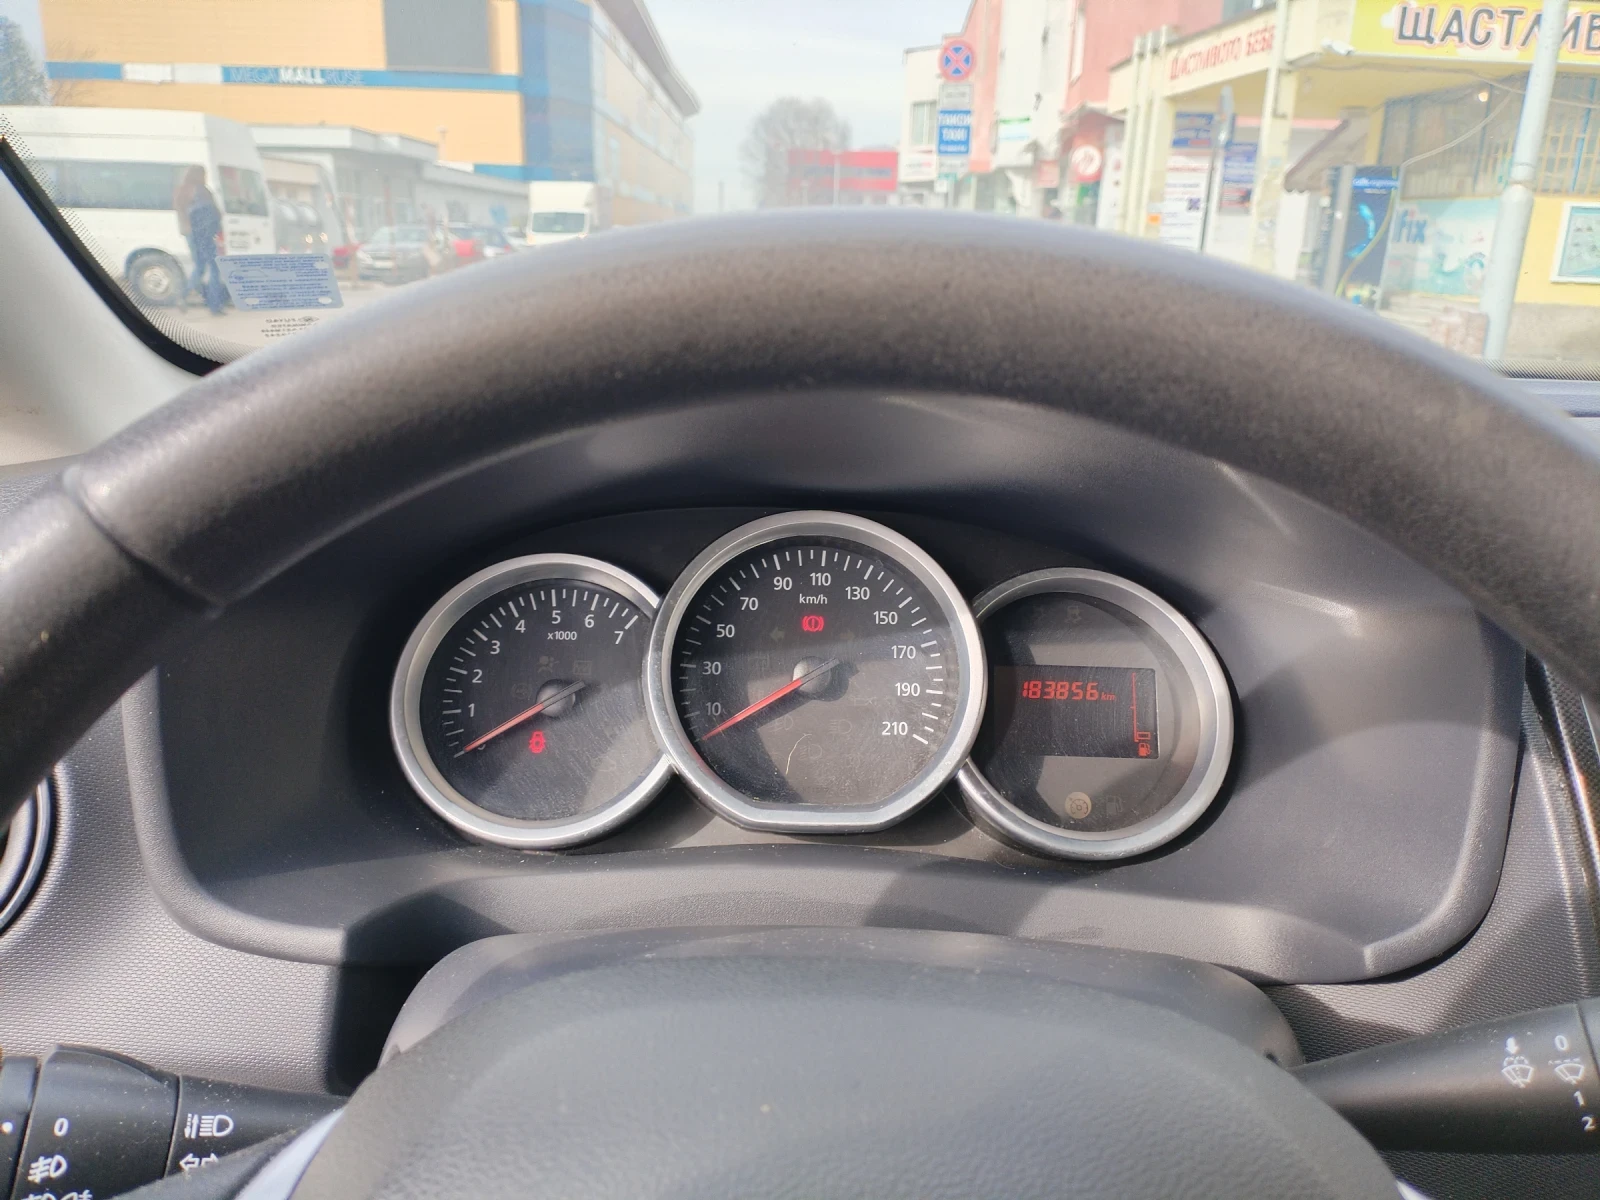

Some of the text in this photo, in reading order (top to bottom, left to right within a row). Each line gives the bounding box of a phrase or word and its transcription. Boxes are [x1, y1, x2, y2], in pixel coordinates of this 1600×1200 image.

[229, 66, 364, 86] MEGA MALL RUSE
[773, 577, 792, 591] 90
[809, 572, 831, 586] 110
[799, 593, 828, 604] km/h
[845, 586, 870, 600] 130
[740, 597, 759, 611] 70
[551, 611, 562, 625] 5
[584, 614, 595, 628] 6
[873, 611, 898, 625] 150
[515, 619, 526, 634] 4
[716, 624, 735, 638] 50
[547, 630, 578, 641] x1000
[614, 630, 624, 645] 7
[490, 640, 500, 655] 3
[891, 645, 916, 659] 170
[702, 661, 721, 675] 30
[472, 669, 483, 683] 2
[894, 682, 920, 697] 190
[1022, 680, 1116, 701] 183856 km
[468, 703, 475, 717] 1
[705, 702, 722, 716] 10
[882, 721, 908, 736] 210
[1554, 1035, 1569, 1051] 0
[1573, 1090, 1585, 1107] 1
[53, 1117, 69, 1137] 0
[1581, 1116, 1596, 1131] 2
